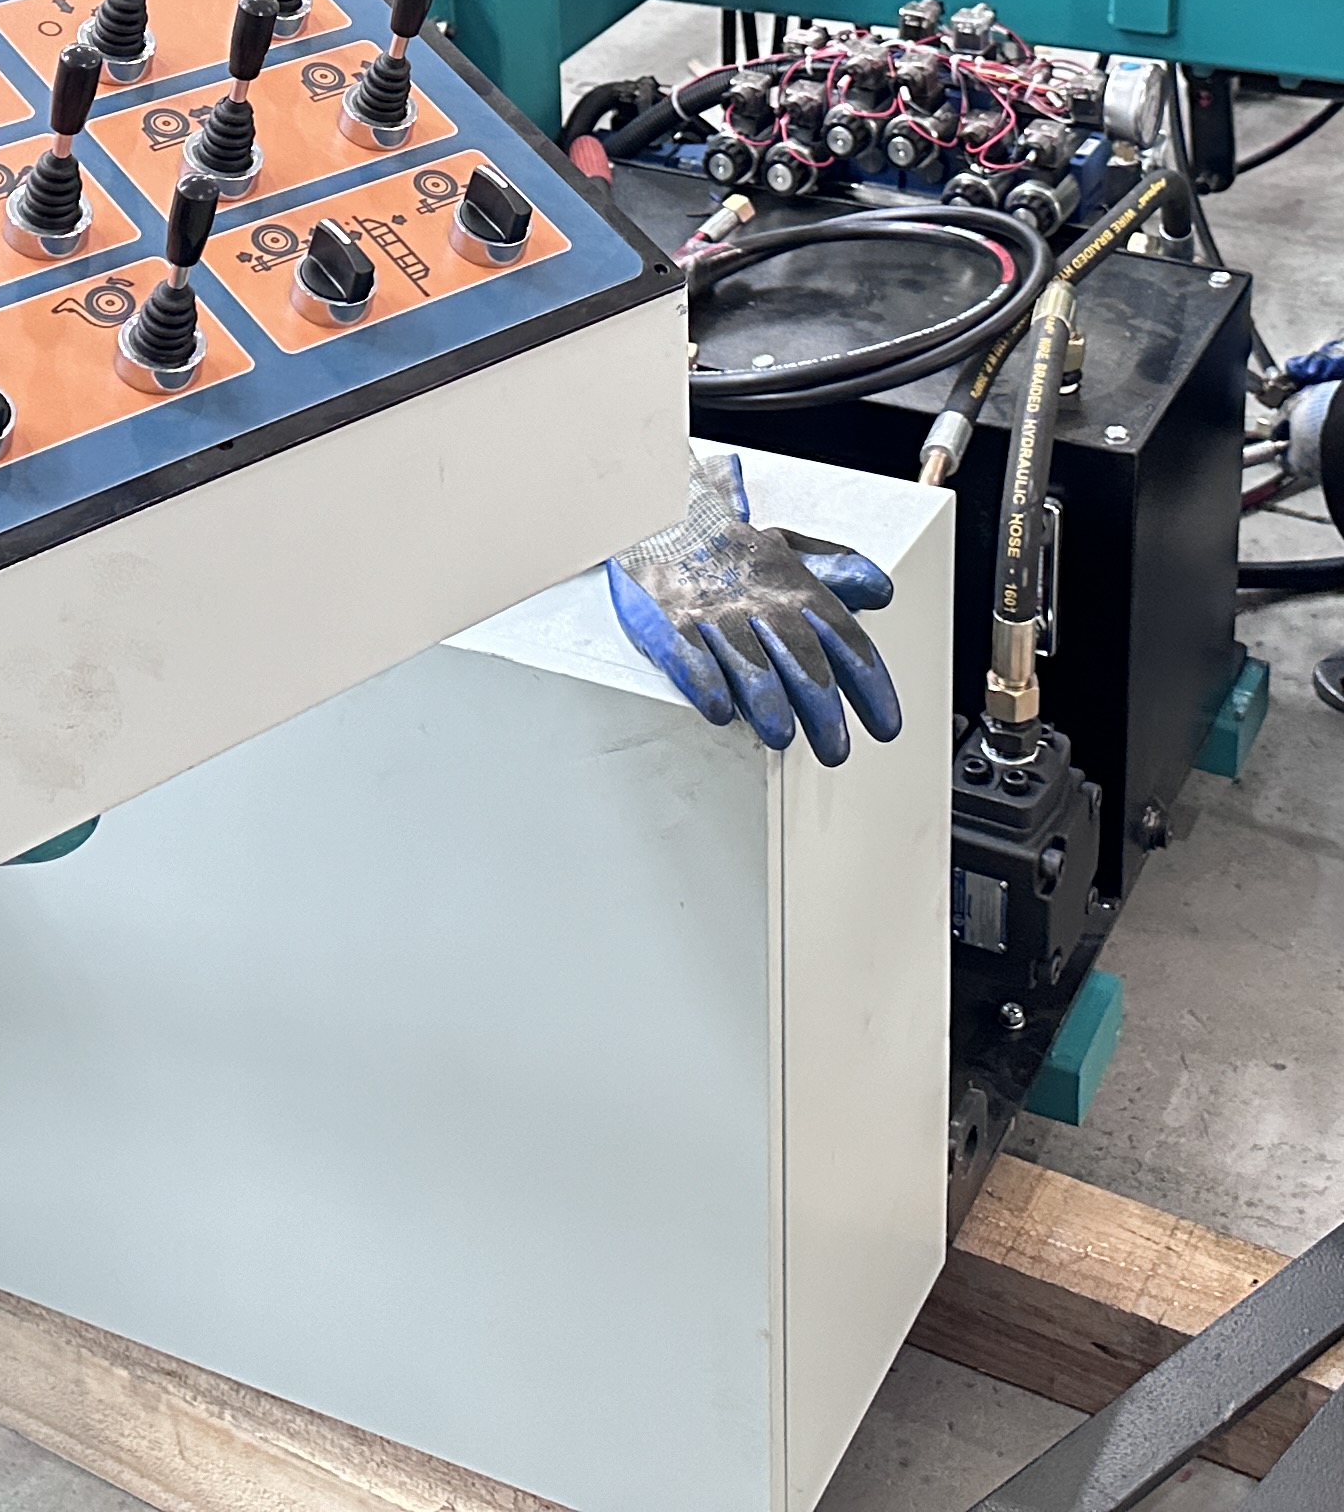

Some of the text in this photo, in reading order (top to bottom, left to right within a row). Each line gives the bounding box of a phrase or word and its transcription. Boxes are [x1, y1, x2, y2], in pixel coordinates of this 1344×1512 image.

[1109, 208, 1137, 234] WIRE
[1071, 229, 1115, 270] BRAIDED
[1035, 337, 1052, 361] WIRE
[1026, 362, 1048, 413] BRAIDED
[1012, 418, 1038, 506] HYDRAULIC
[1007, 512, 1025, 559] HOSE
